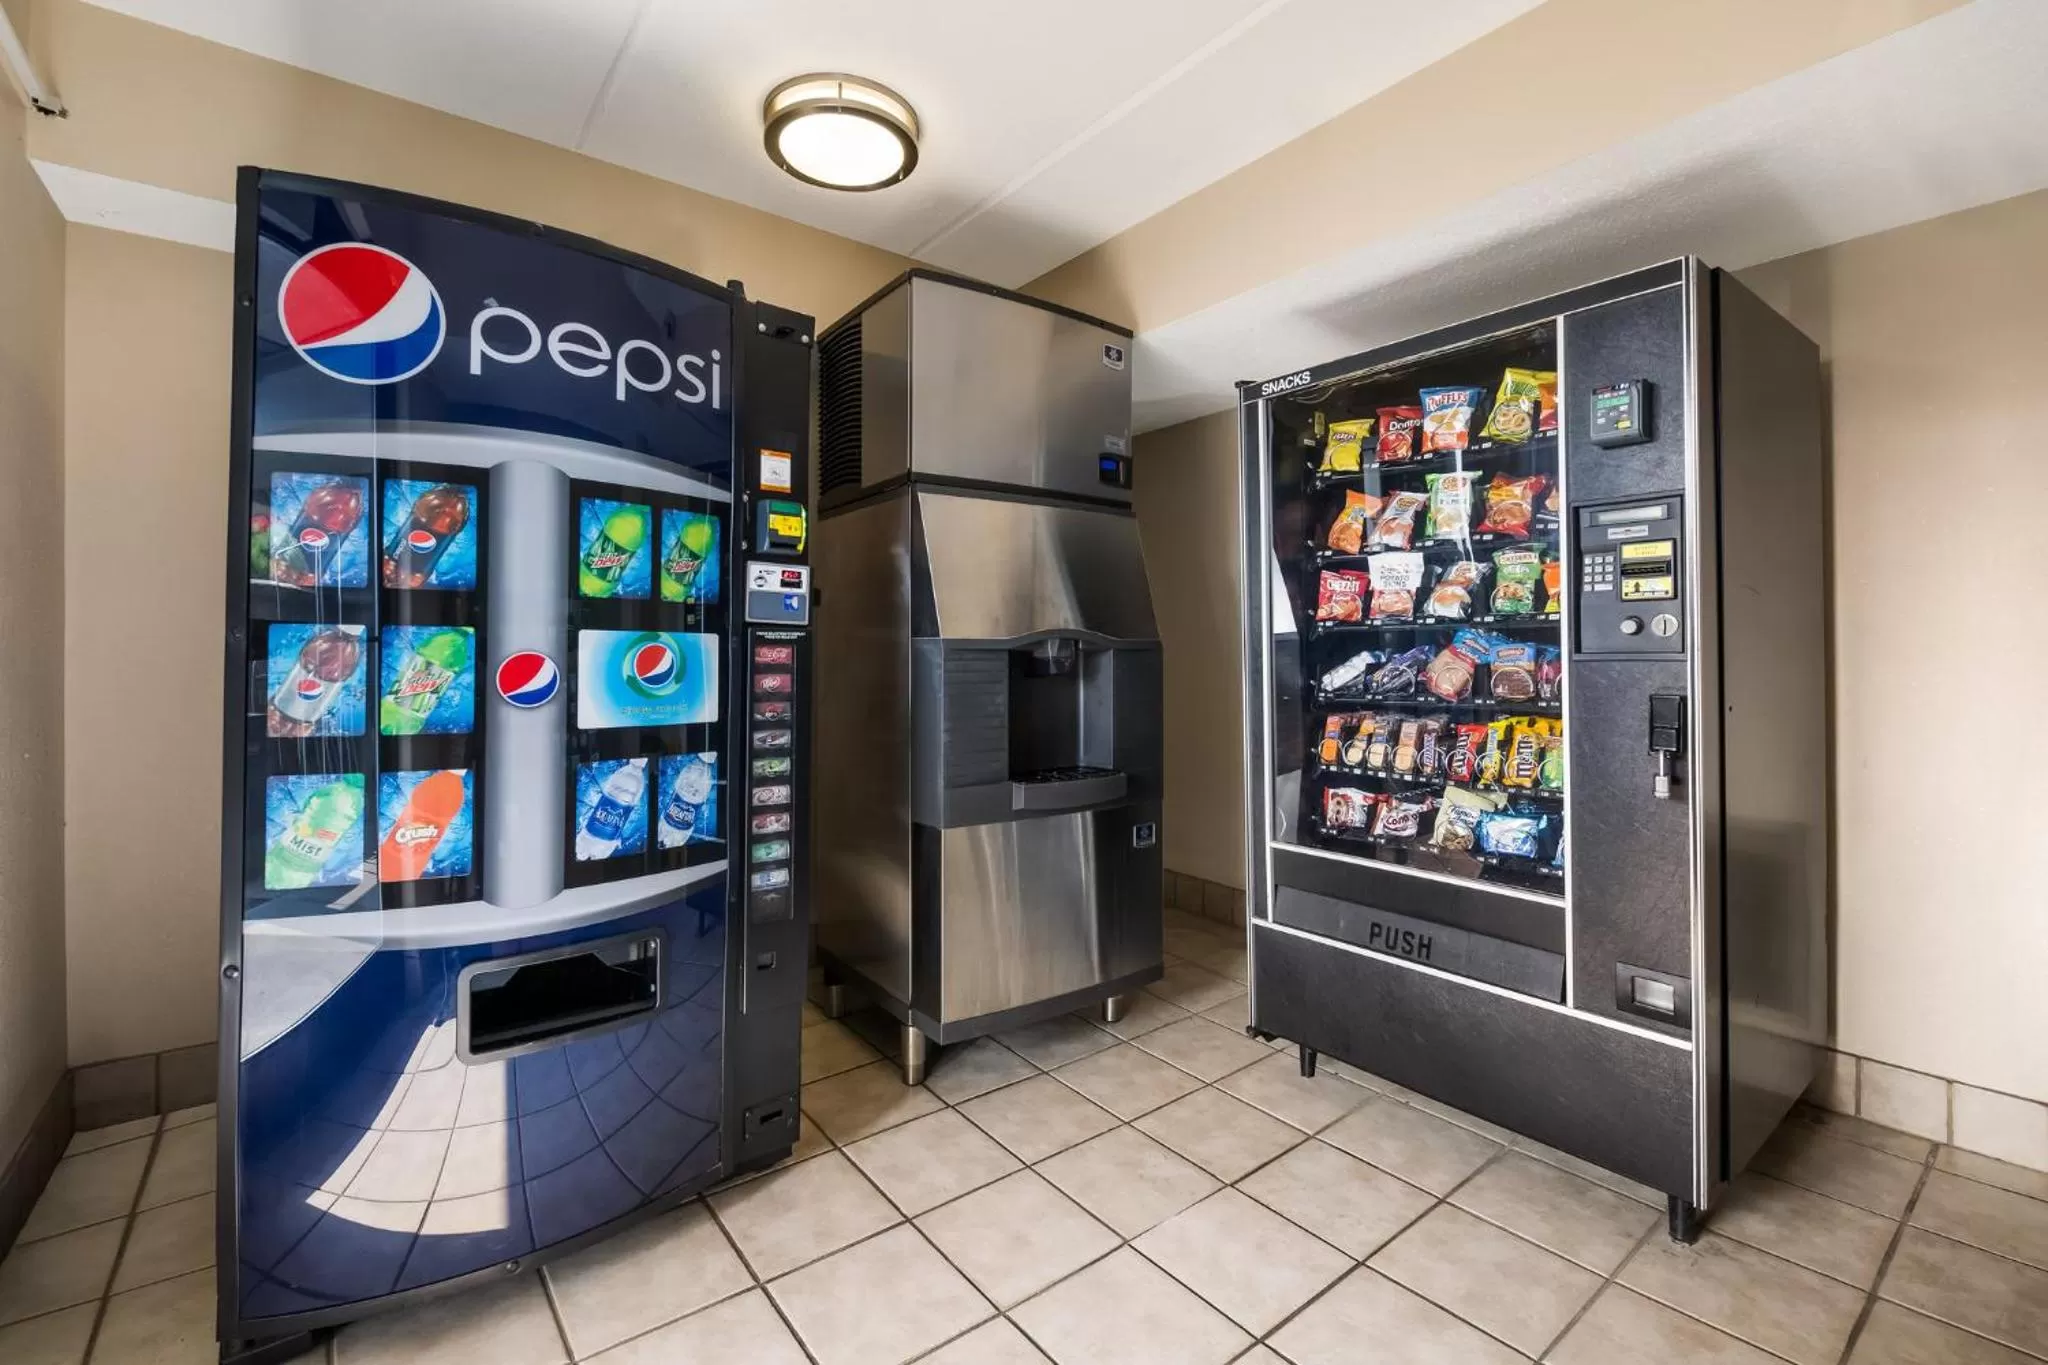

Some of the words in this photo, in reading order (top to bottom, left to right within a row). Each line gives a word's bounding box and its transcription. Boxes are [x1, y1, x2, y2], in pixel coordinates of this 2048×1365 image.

[469, 307, 721, 409] pepsi
[1262, 371, 1311, 396] SNACKS
[1369, 921, 1432, 960] PUSH
